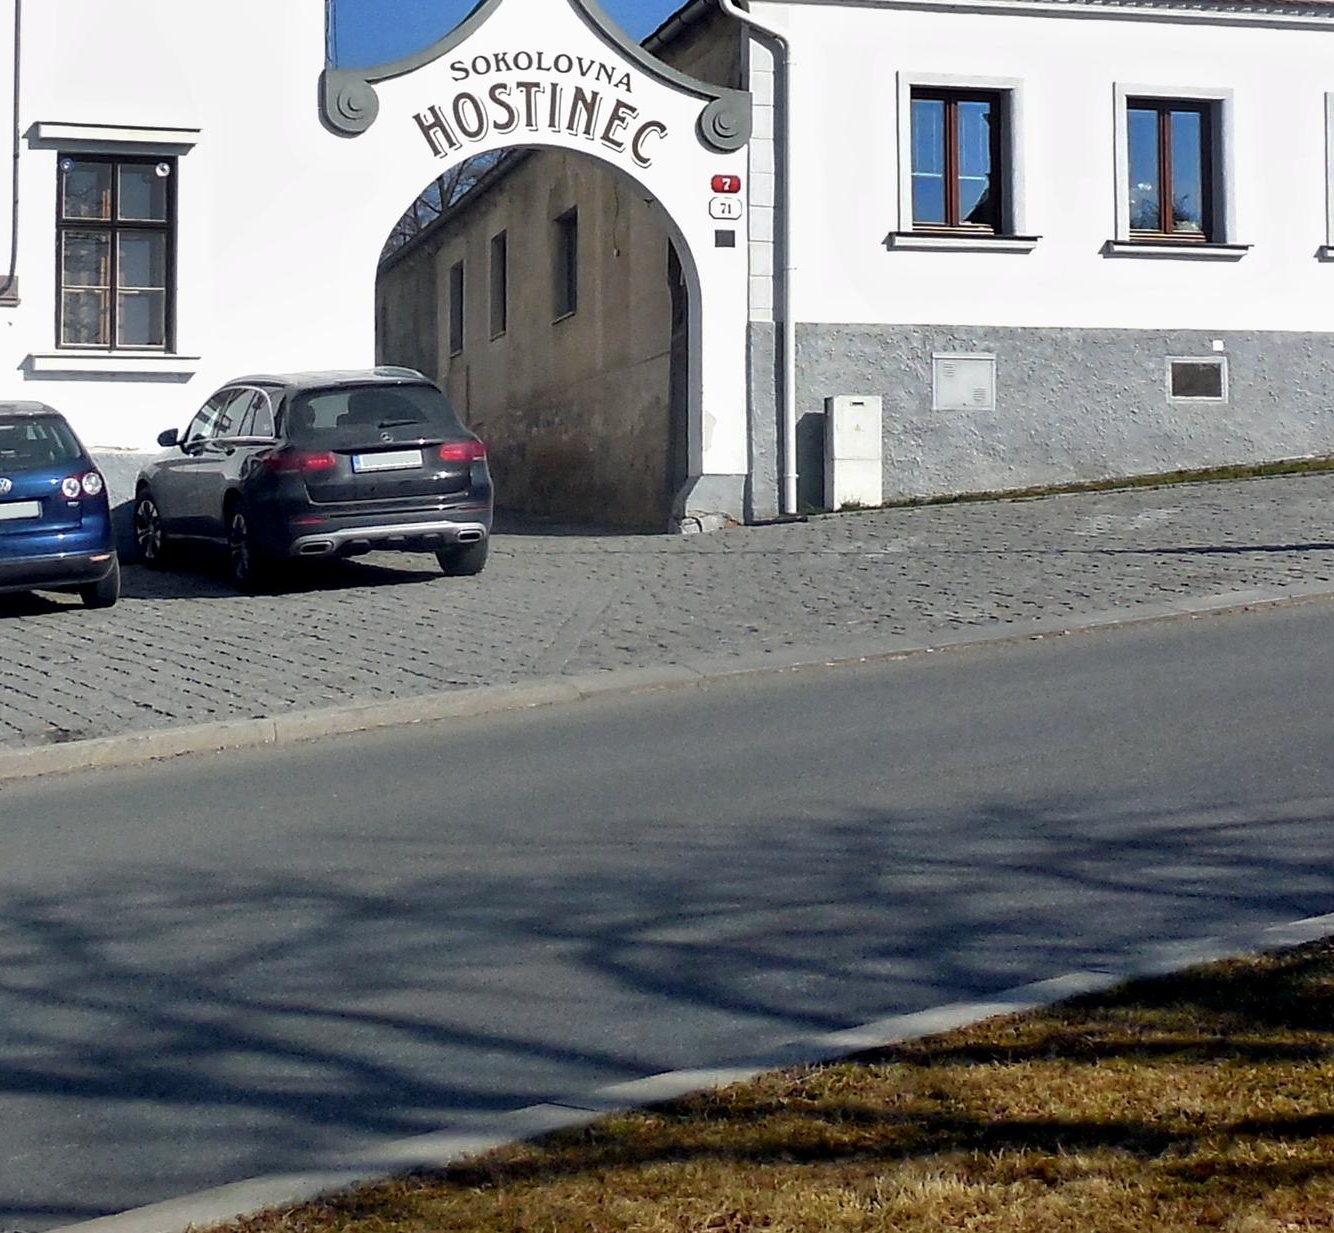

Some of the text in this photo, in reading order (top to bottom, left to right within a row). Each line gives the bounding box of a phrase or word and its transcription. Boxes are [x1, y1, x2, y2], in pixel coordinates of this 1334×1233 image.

[449, 51, 632, 93] SOKOLOVNA
[412, 81, 668, 169] HOSTINEC
[722, 177, 731, 191] 7
[720, 203, 731, 214] 71
